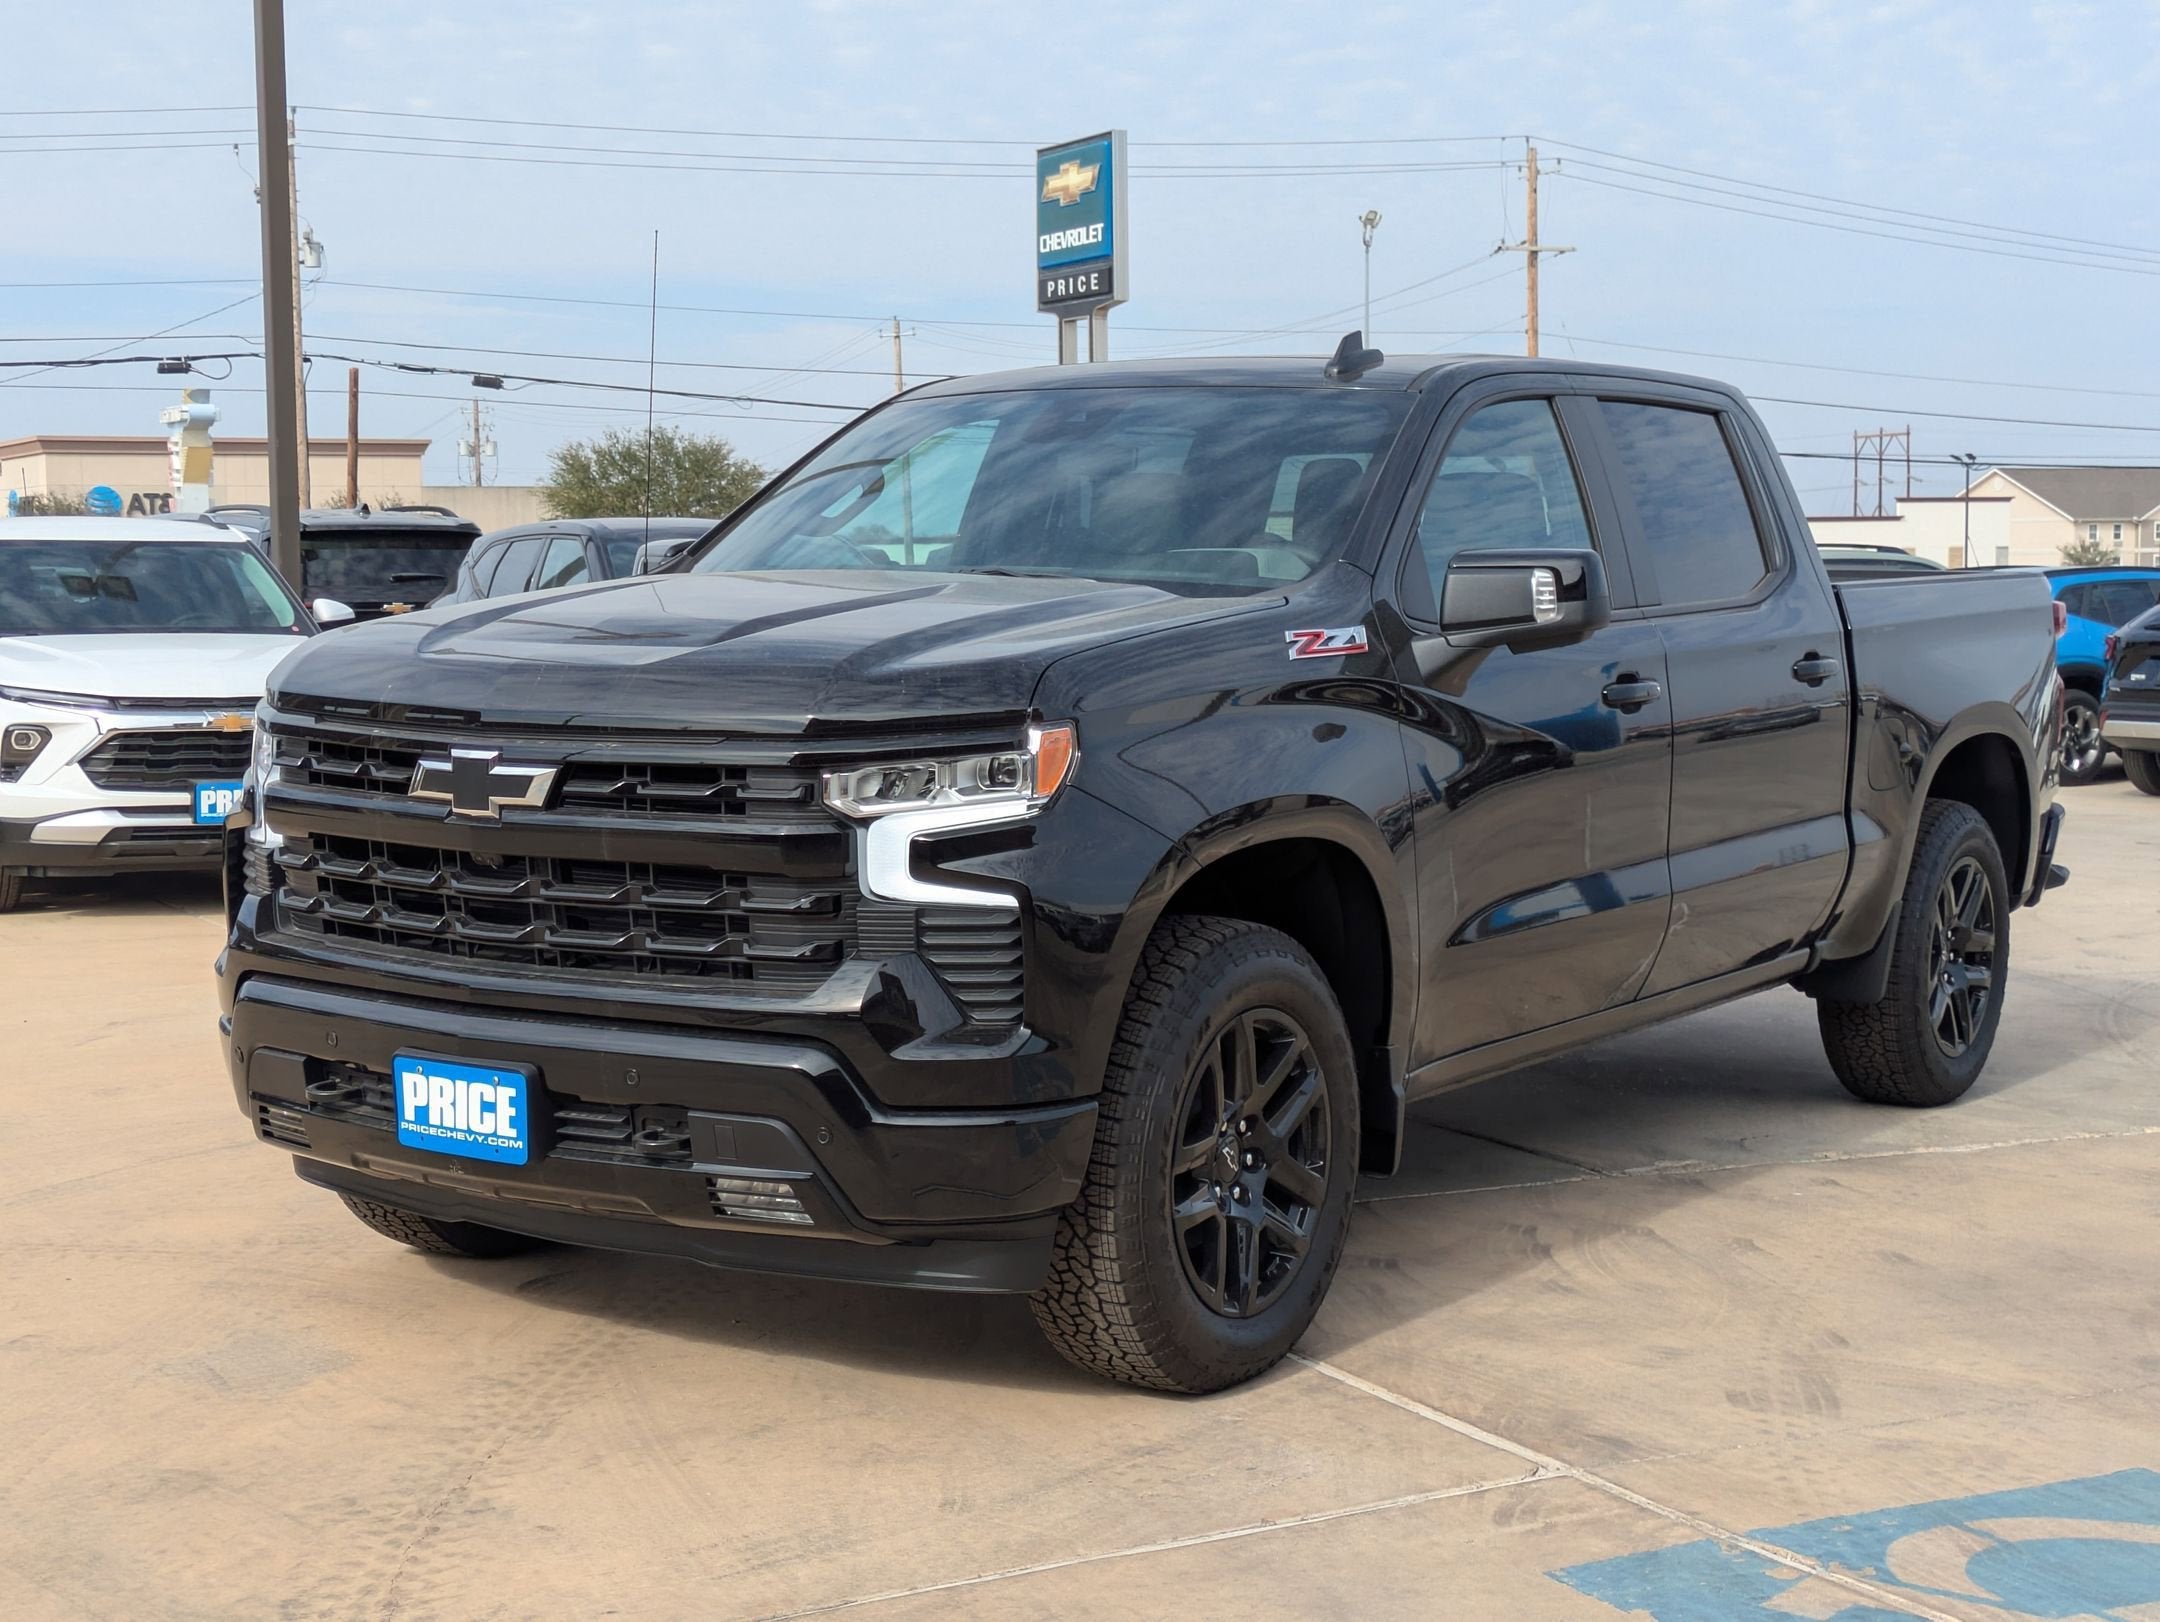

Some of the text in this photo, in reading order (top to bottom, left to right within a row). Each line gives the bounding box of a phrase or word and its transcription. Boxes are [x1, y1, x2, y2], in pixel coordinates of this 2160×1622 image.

[1040, 223, 1104, 253] CHEVROLET
[1048, 273, 1100, 297] PRICE
[402, 1072, 517, 1137] PRICE
[401, 1122, 523, 1149] PRICECHEVY.COM
